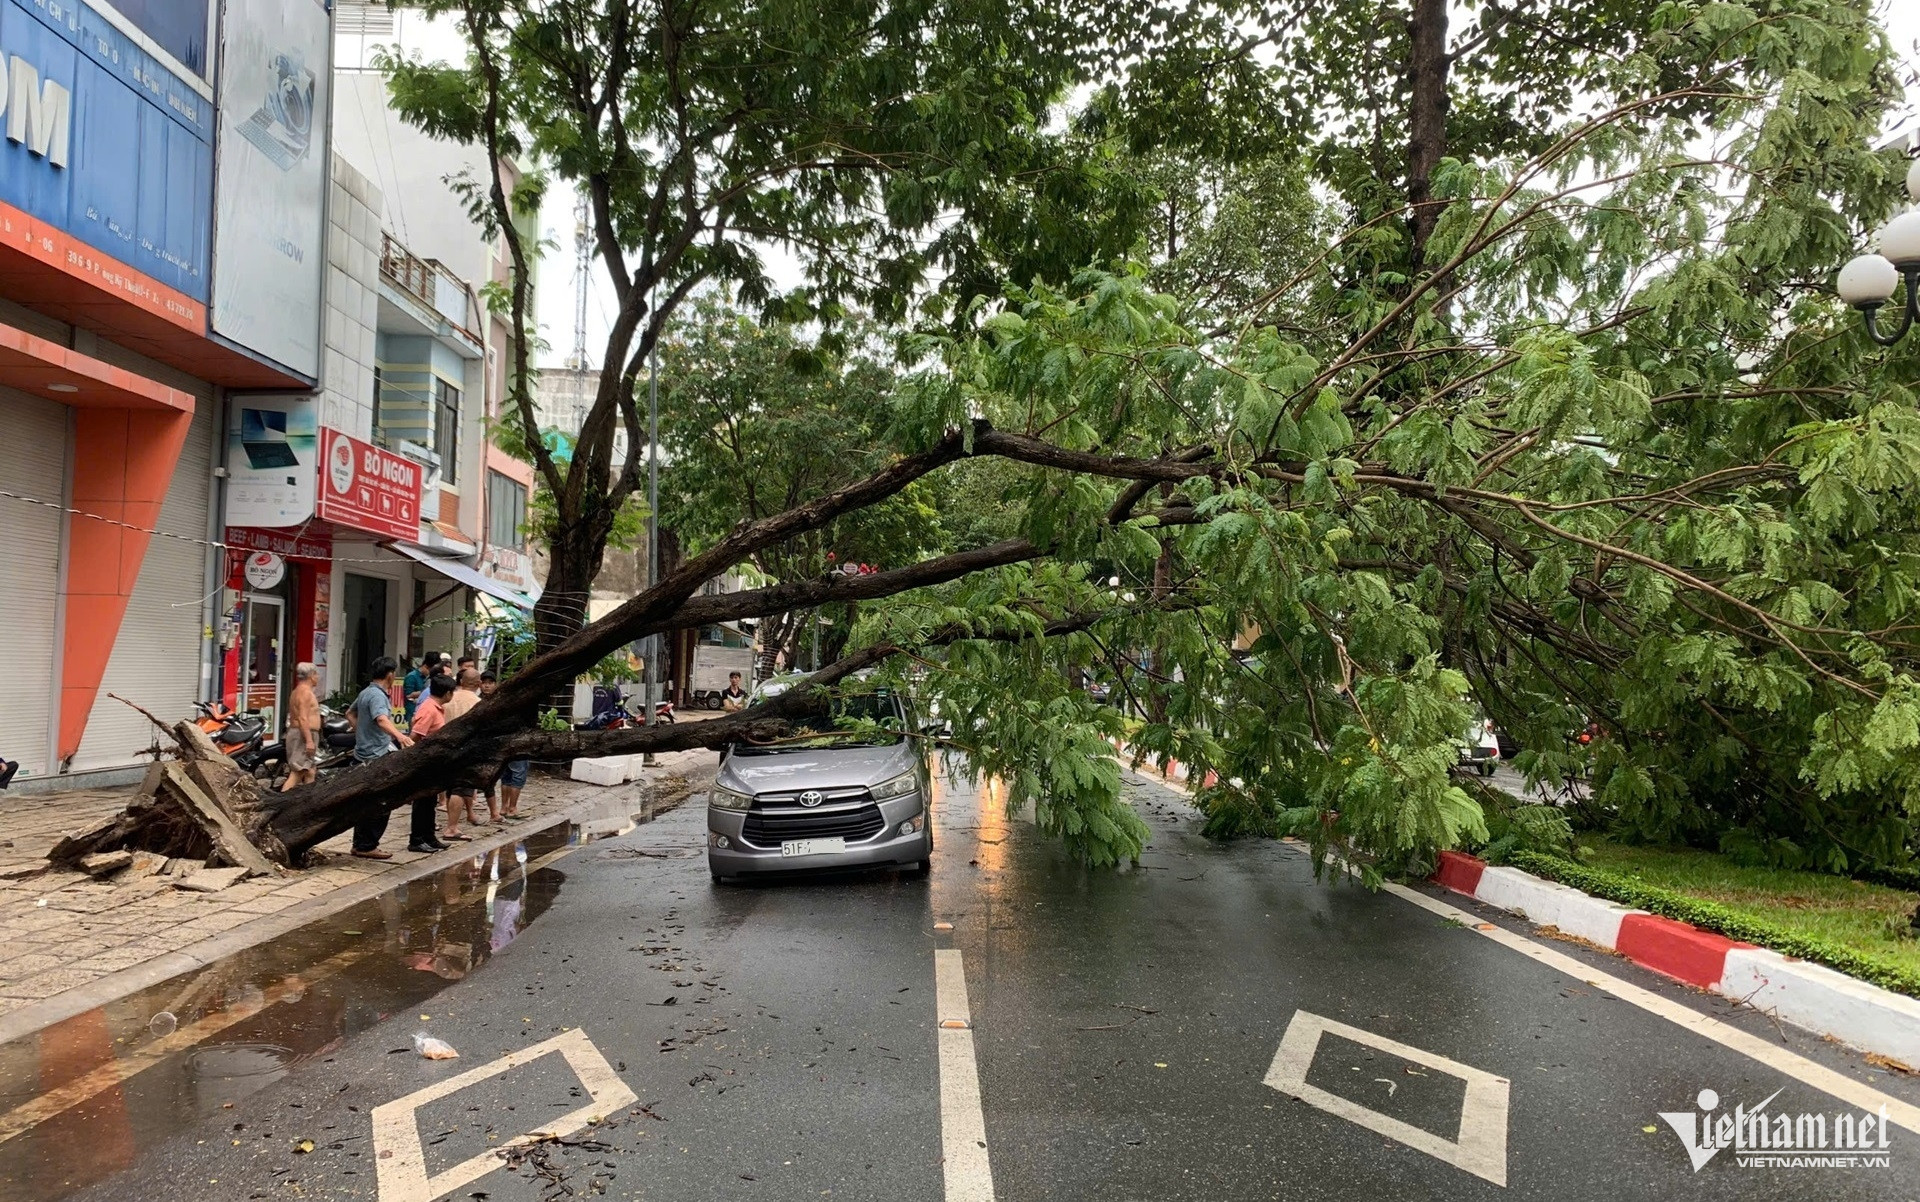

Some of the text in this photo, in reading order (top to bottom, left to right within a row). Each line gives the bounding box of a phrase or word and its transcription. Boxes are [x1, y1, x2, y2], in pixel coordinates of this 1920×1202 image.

[0, 47, 70, 169] M
[364, 448, 381, 476] BÒ
[382, 458, 414, 489] NGON
[228, 527, 248, 545] BEEF
